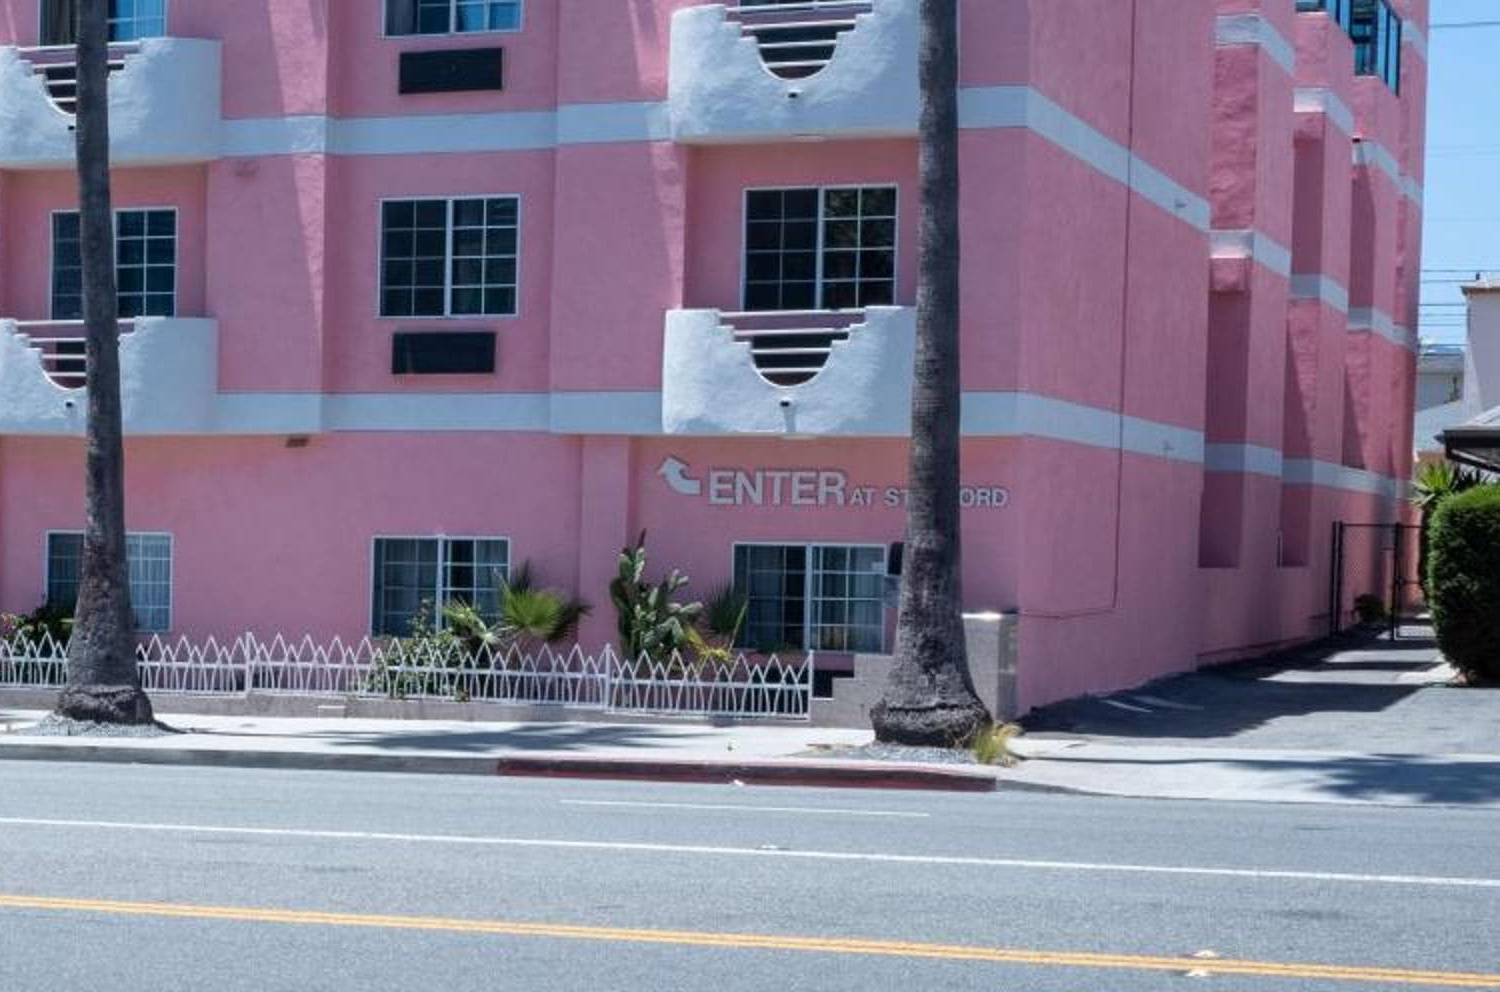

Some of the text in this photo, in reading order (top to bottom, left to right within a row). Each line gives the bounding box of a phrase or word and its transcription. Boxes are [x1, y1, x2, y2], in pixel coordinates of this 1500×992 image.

[708, 471, 1008, 508] ENTER AT STORD
